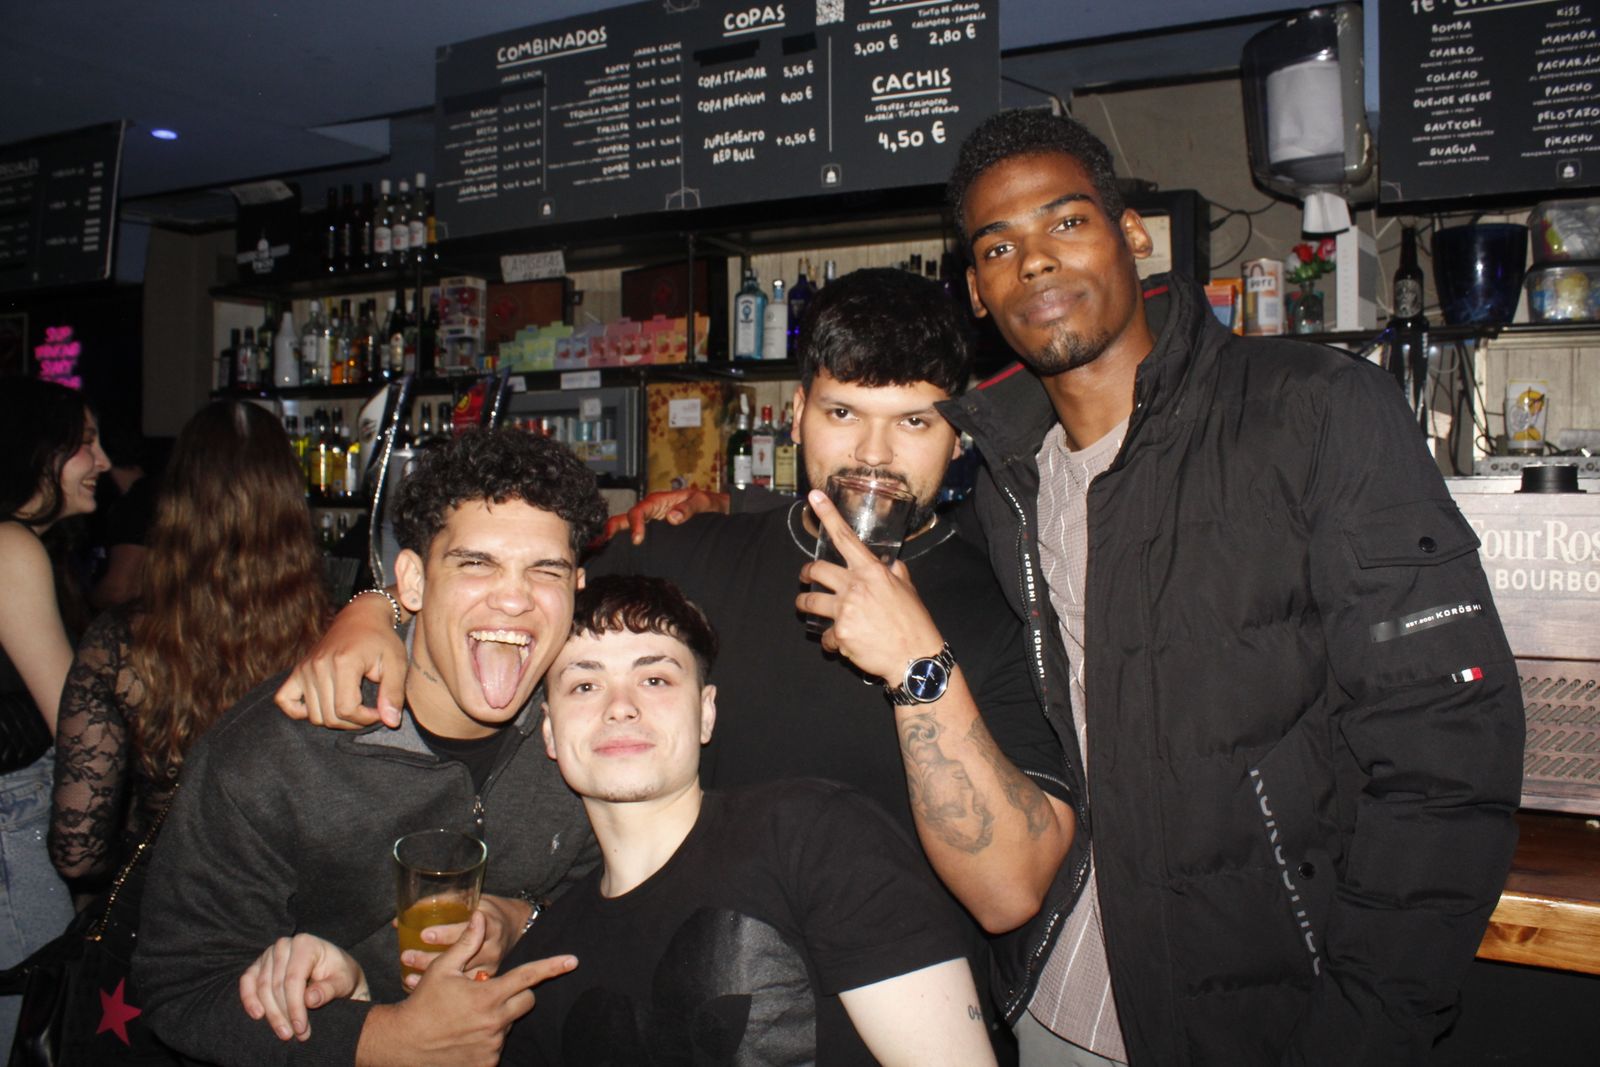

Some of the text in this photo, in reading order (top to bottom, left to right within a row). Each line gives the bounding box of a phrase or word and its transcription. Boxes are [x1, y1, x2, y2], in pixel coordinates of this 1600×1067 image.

[724, 4, 785, 30] COPAS
[1556, 5, 1581, 17] KISS
[856, 20, 893, 32] CERVEZA
[929, 23, 976, 46] 2,80 €
[1431, 20, 1472, 34] BOMBA
[497, 26, 607, 63] COMBINADOS
[854, 34, 899, 56] 3,00 €
[1541, 30, 1596, 45] MAMADA
[1429, 46, 1475, 58] CHARRO
[698, 66, 767, 88] COPA STANDAR
[783, 60, 814, 79] 5,50 €
[1426, 70, 1479, 83] COLACAO
[872, 68, 952, 94] CACHIS
[1545, 82, 1593, 97] PANCHO
[698, 92, 766, 113] COPA PREMIUM
[780, 86, 813, 105] 6,00 €
[1413, 91, 1492, 109] DUENDE VERDE
[1424, 117, 1482, 132] GAUTXORI
[1538, 107, 1600, 124] PELOTAZO
[704, 130, 765, 149] SUPLEMENTO
[784, 133, 807, 147] 0,50
[808, 128, 816, 142] €
[878, 120, 946, 153] 4,50 €
[1545, 134, 1593, 148] PIKACHU
[713, 147, 755, 165] RED BULL
[1430, 143, 1477, 157] GUAGUA
[1024, 553, 1038, 602] KOROSHI
